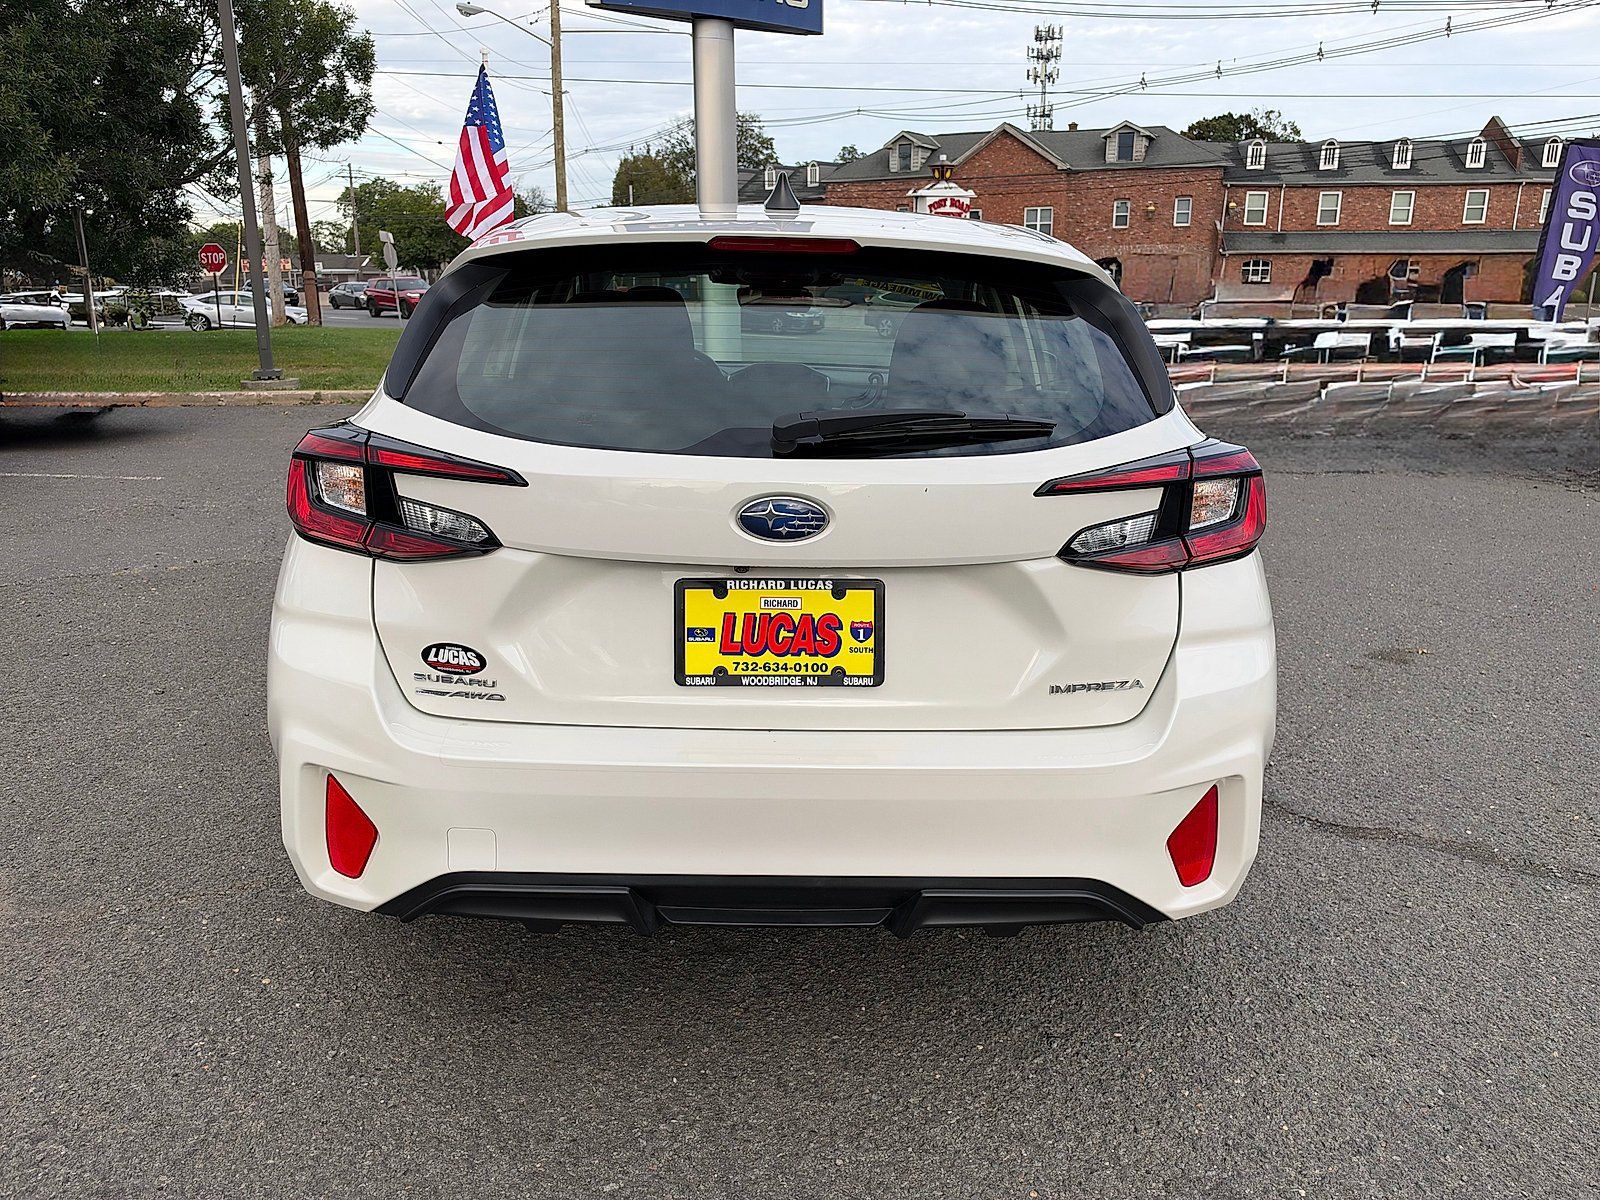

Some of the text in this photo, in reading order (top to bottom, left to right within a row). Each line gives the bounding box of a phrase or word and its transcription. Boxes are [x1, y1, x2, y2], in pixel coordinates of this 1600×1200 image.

[928, 198, 971, 214] POST ROAD
[200, 252, 225, 264] STOP
[726, 580, 833, 590] RICHARD LUCAS
[763, 599, 799, 608] RICHARD
[719, 612, 843, 659] LUCAS
[857, 628, 866, 641] 1
[849, 646, 874, 654] SOUTH
[427, 647, 481, 667] LUCAS
[732, 661, 828, 673] 732-634-0100
[413, 672, 498, 688] SUBARU
[685, 676, 716, 686] SUBARU
[741, 676, 818, 687] WOODBRIDGE, NJ
[843, 676, 874, 686] SUBARU
[1048, 678, 1145, 696] IMPREZA
